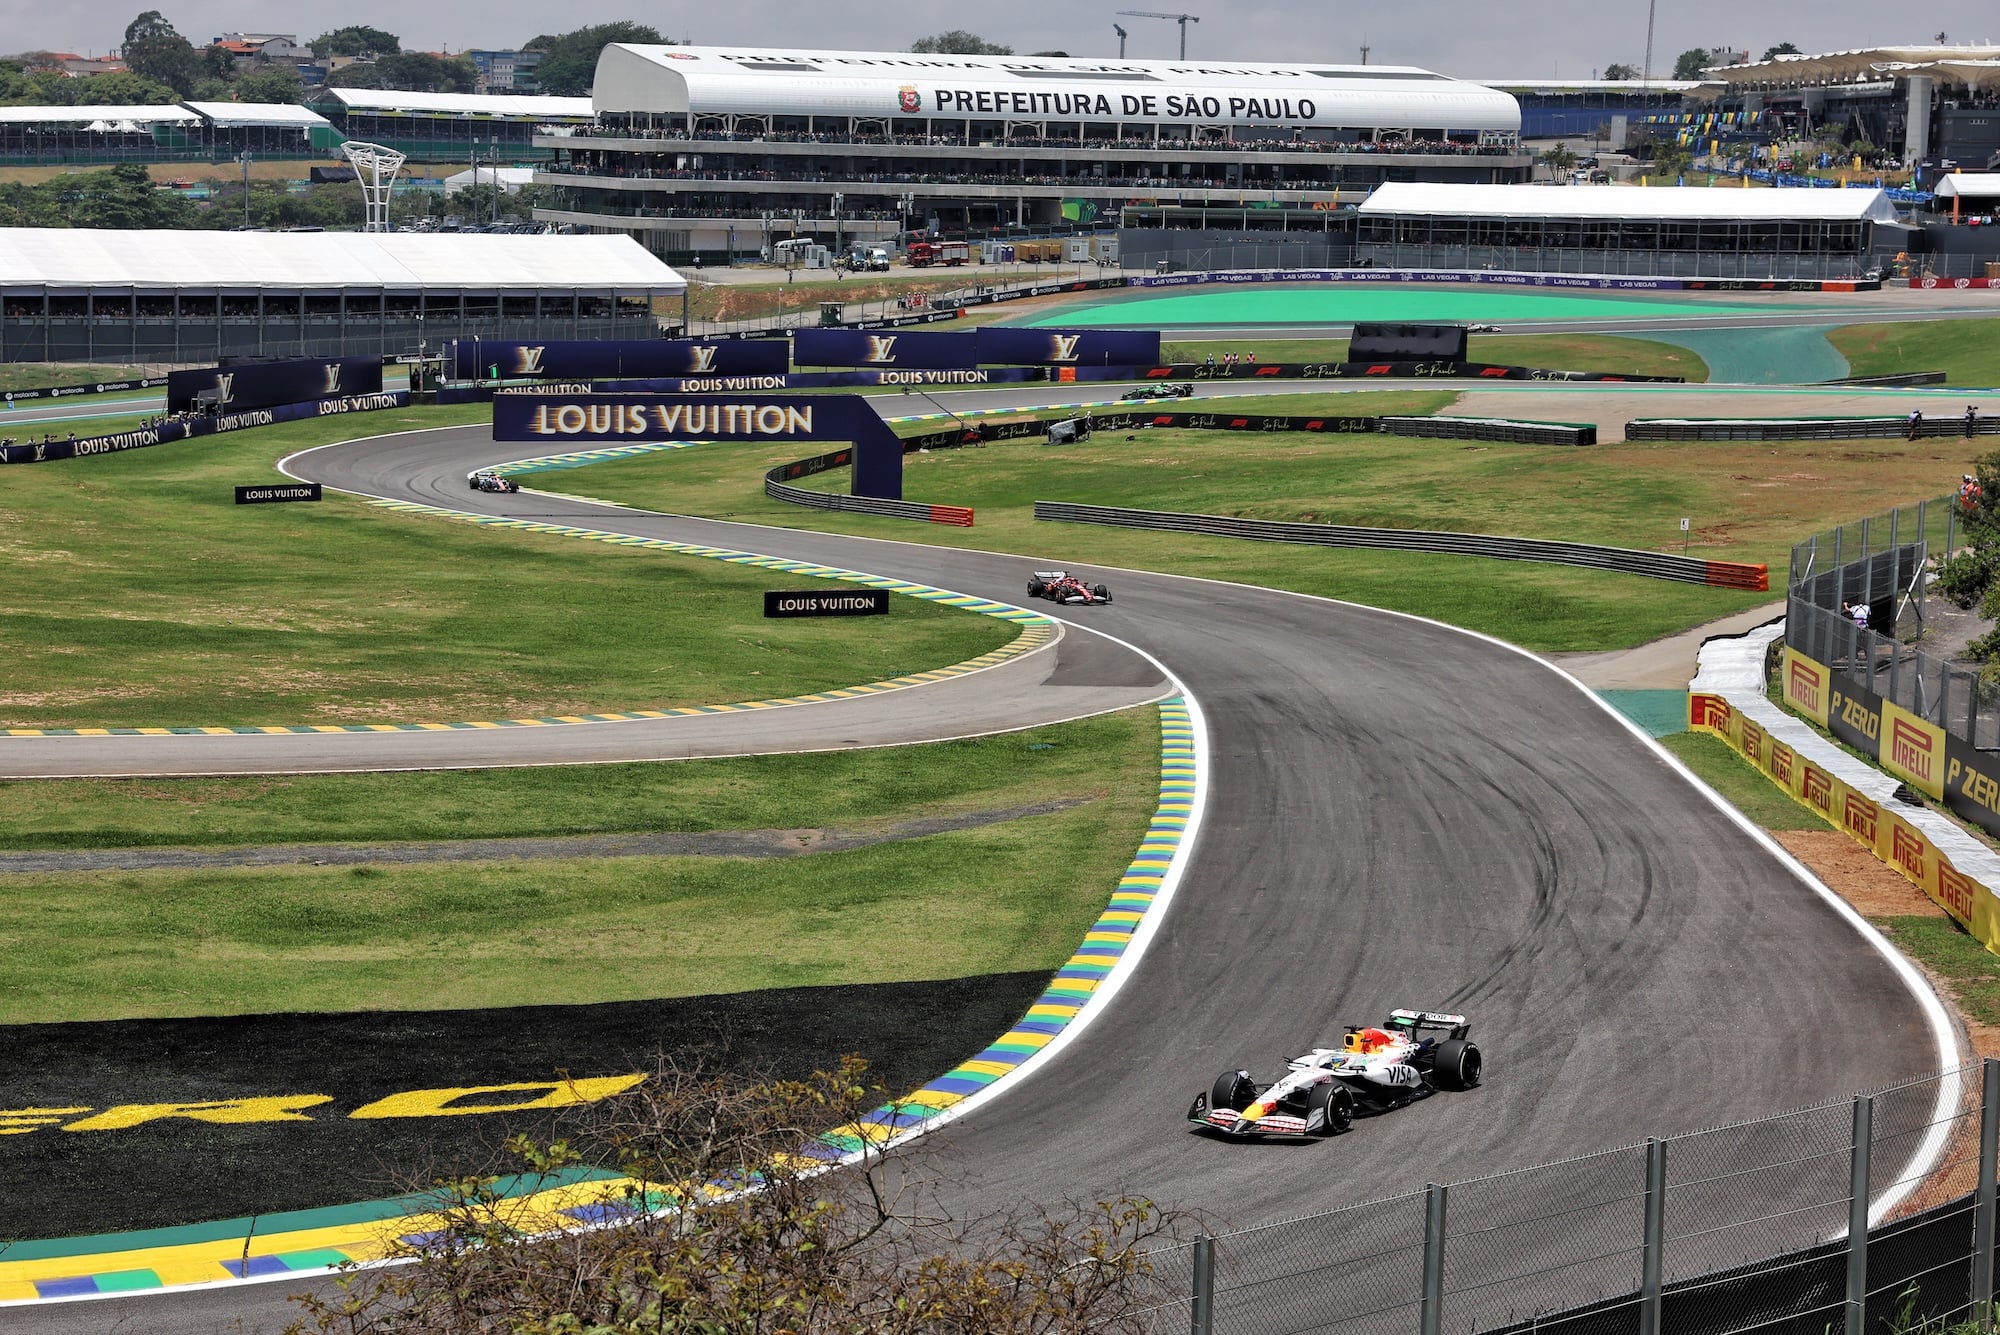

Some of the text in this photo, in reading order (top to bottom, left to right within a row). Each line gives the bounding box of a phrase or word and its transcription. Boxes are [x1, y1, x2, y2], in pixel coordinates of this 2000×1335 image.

[1000, 63, 1062, 71] DE
[1167, 67, 1301, 77] PAULO
[934, 88, 1317, 120] PREFEITURA DE SÃO PAULO
[105, 382, 130, 391] motorola
[150, 378, 169, 386] motoro
[682, 375, 786, 393] LOUIS VUITTON
[880, 370, 988, 385] LOUIS VUITTON
[14, 391, 39, 399] motorola
[60, 387, 85, 395] motorola
[319, 394, 398, 416] LOUIS VUITTON
[216, 410, 273, 431] LOUIS VUITTON
[540, 404, 813, 434] LOUIS VUITTON
[74, 428, 159, 456] LOUIS VUITTON
[246, 488, 312, 500] LOUIS VUITTON
[779, 597, 875, 611] LOUIS VUITTON
[1790, 659, 1820, 713] PIRELLI
[1831, 690, 1879, 741] P ZERO
[1892, 716, 1933, 782] PIRELLI
[1802, 766, 1832, 812] PIRELLI
[1947, 757, 2000, 815] P ZER
[1938, 858, 1974, 922] PIRELLI
[1383, 1065, 1412, 1084] VISA
